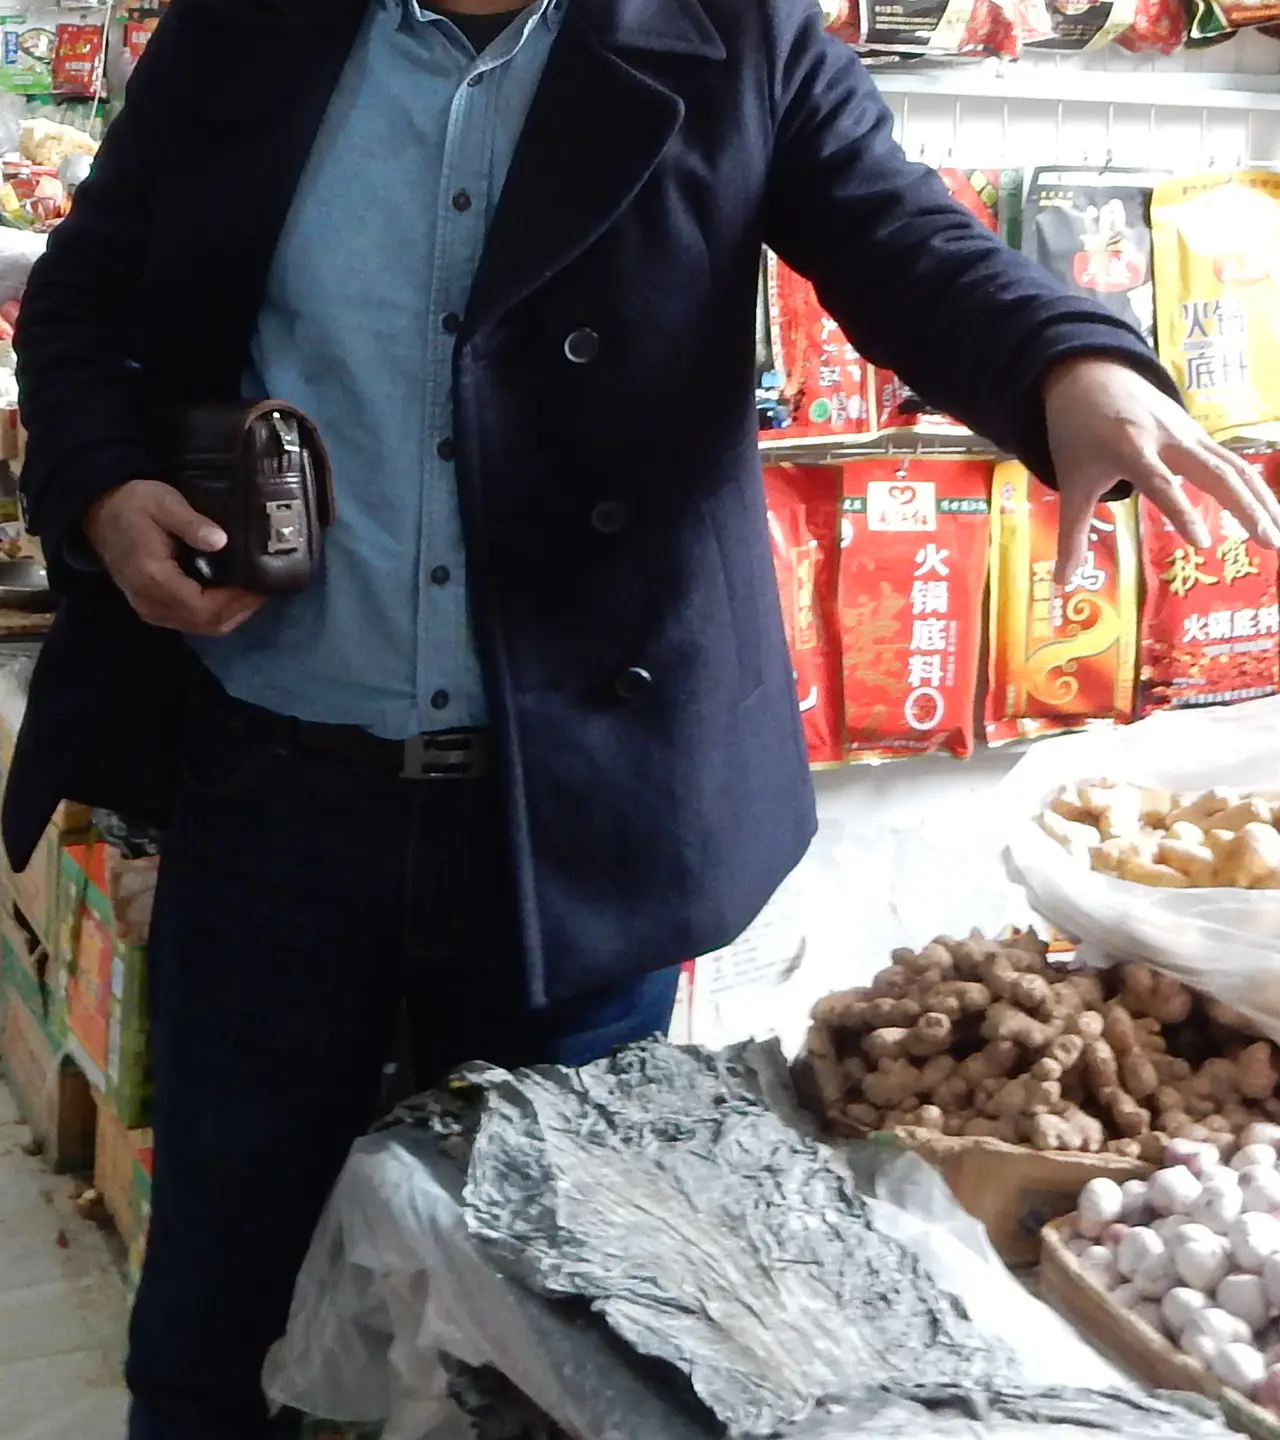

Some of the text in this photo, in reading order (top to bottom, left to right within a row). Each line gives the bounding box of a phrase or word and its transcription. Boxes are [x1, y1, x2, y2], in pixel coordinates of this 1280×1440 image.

[1161, 533, 1260, 598] 秋霞
[908, 542, 951, 688] 火锅底料
[1181, 603, 1280, 644] 火锅底料
